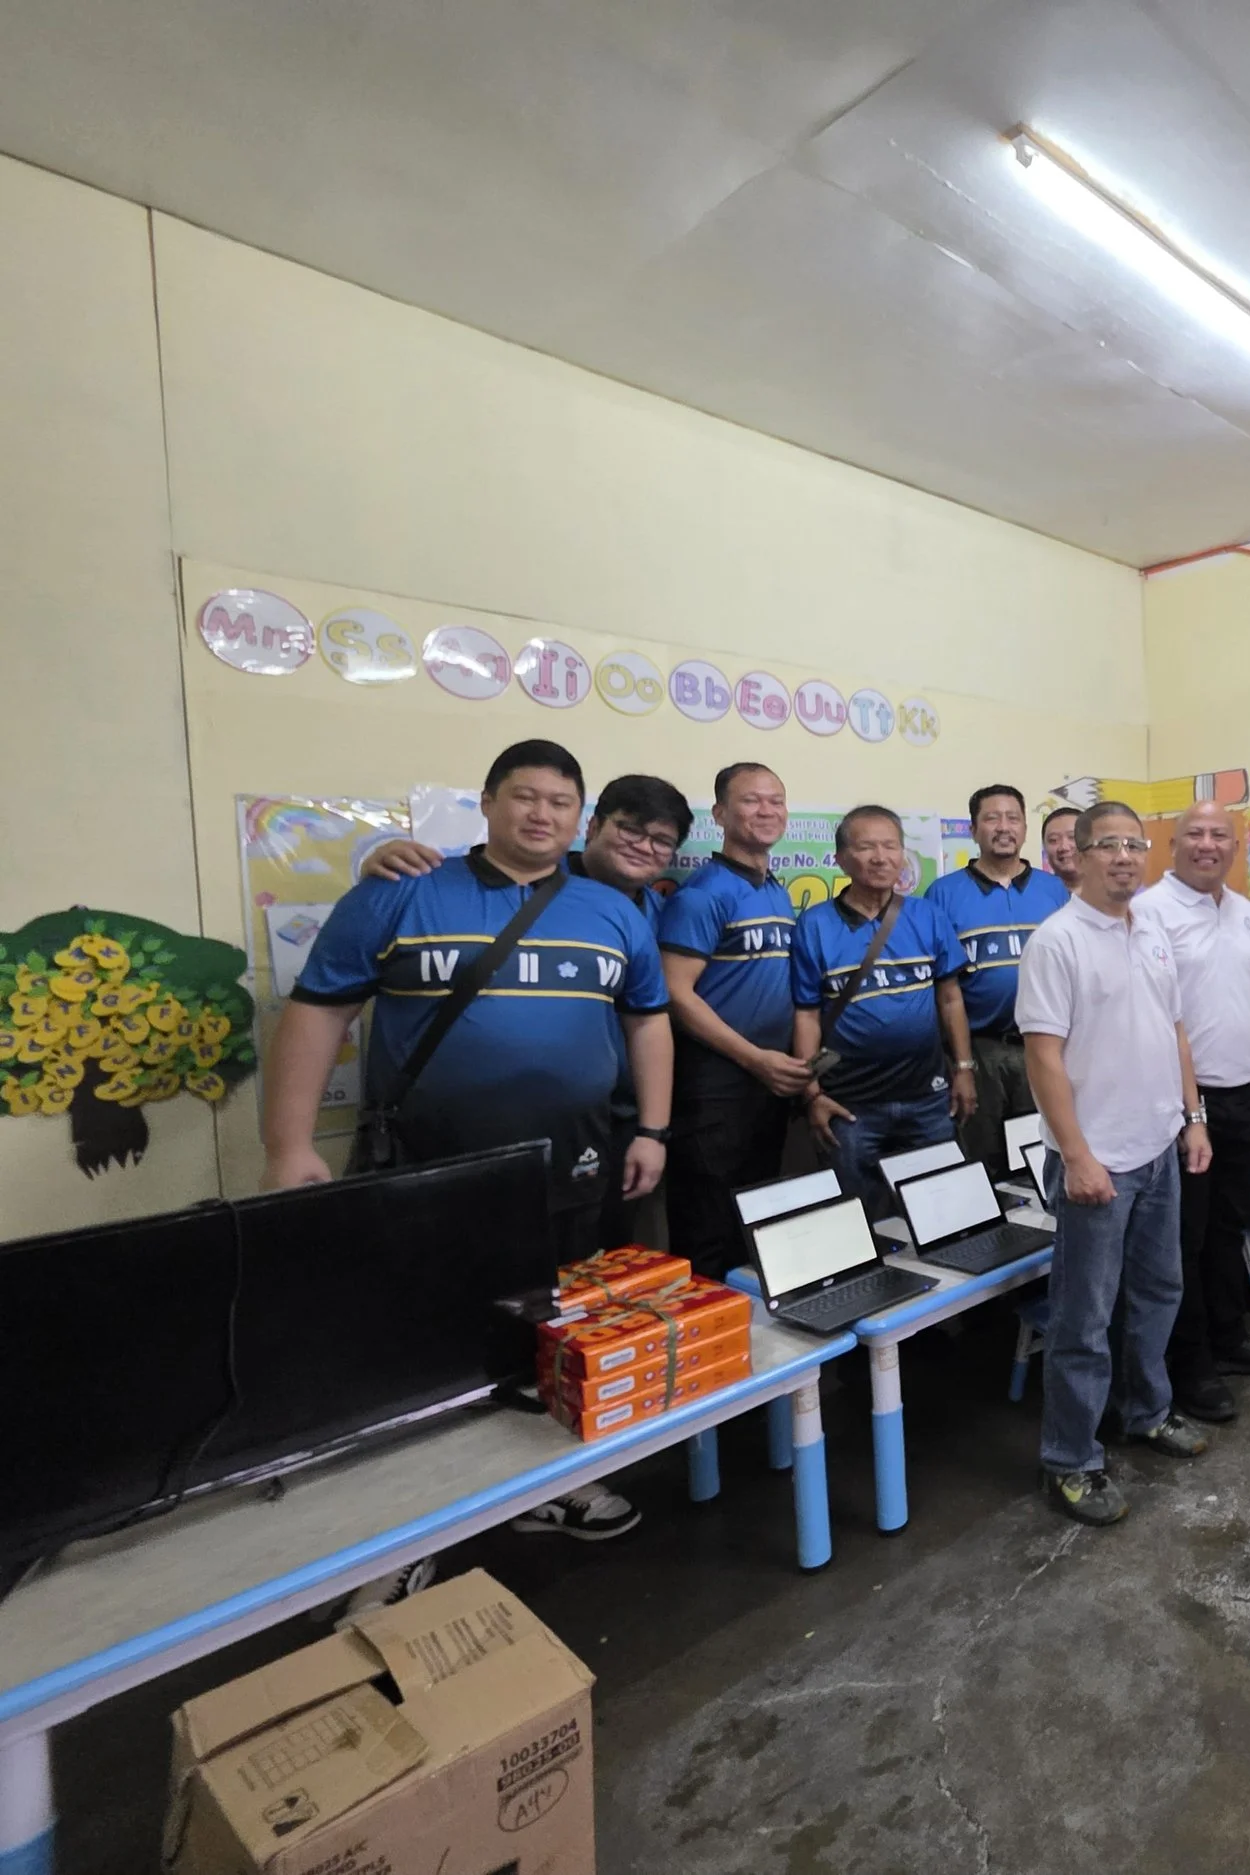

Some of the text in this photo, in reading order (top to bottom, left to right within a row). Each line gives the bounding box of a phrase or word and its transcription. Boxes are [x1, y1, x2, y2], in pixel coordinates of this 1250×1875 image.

[532, 650, 578, 701] Ii
[602, 664, 663, 701] Oo
[674, 671, 730, 711] Bb
[739, 680, 788, 720] Ee
[800, 693, 846, 724] Uu
[853, 698, 892, 737] Tt
[795, 854, 818, 867] No.
[420, 950, 460, 981] IV
[597, 956, 621, 987] VI
